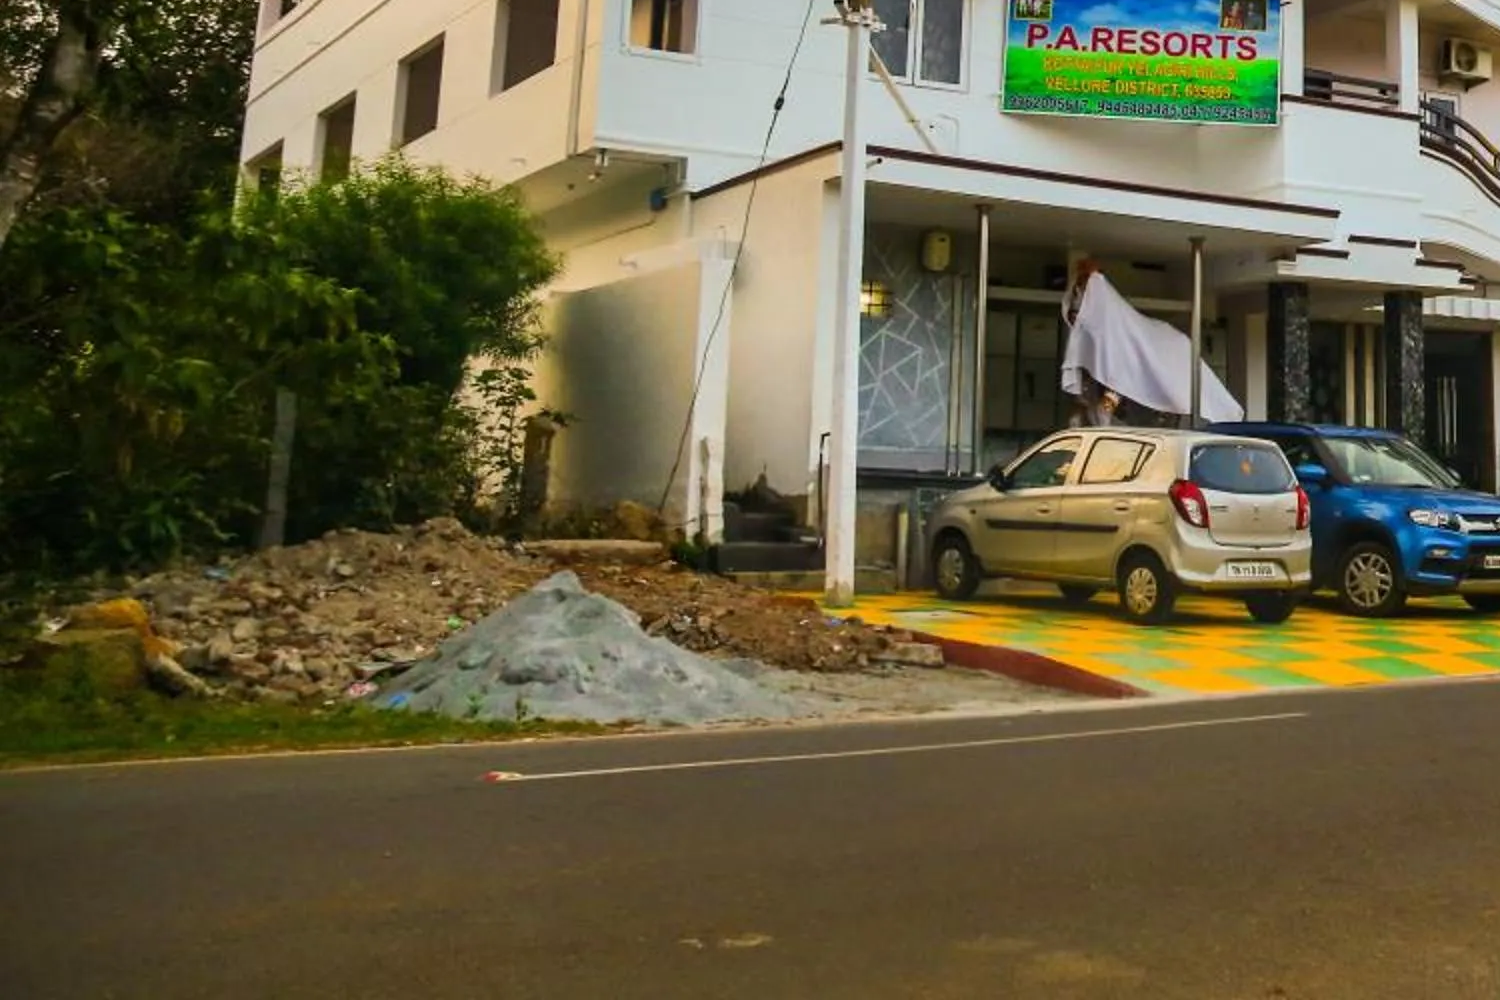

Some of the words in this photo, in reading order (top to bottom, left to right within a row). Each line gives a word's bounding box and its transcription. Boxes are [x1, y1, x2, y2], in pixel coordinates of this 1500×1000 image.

[1026, 23, 1258, 61] P.A.RESORTS
[1045, 76, 1111, 94] VELLORE
[1115, 80, 1181, 99] DISTRICT,
